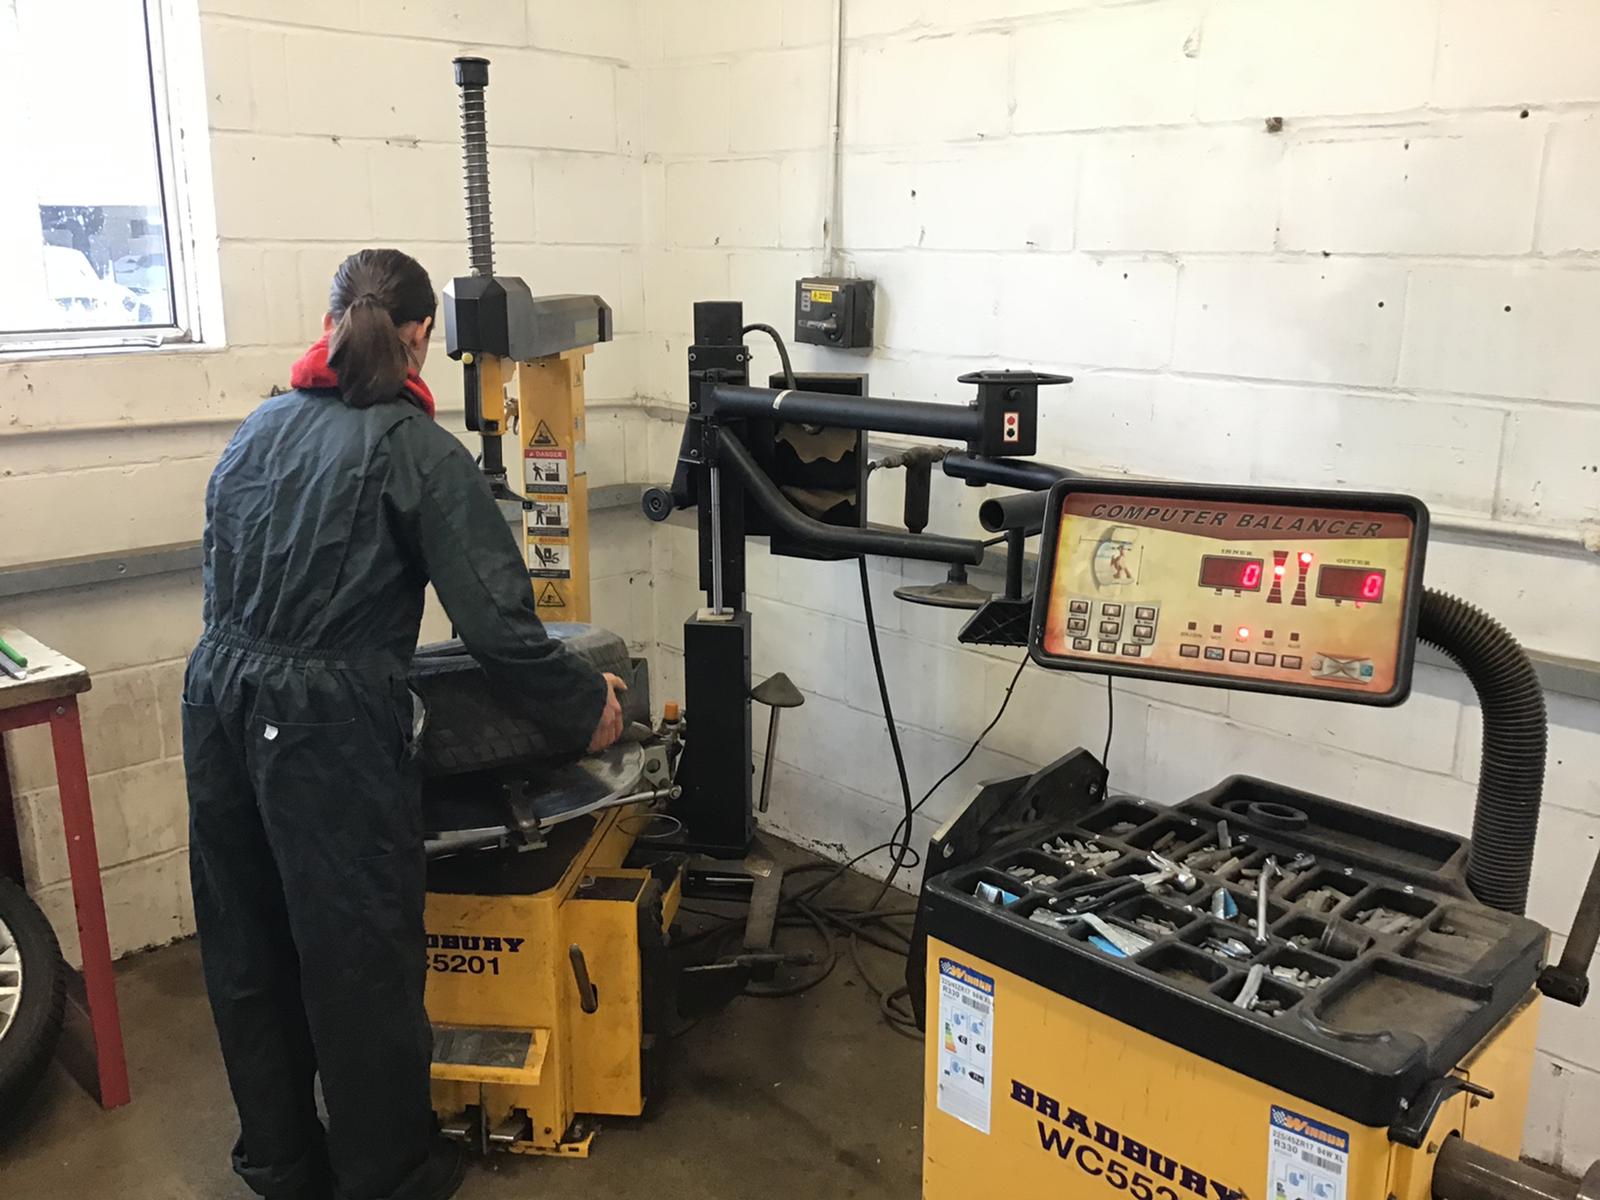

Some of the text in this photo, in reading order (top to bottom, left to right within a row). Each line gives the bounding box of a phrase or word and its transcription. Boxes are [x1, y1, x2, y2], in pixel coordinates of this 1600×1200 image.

[1091, 503, 1382, 538] COMPUTER BALANCER
[1221, 548, 1253, 556] INNER
[1336, 558, 1371, 566] OUTER
[1242, 564, 1260, 586] 0
[1362, 574, 1382, 598] 0
[426, 953, 499, 976] 5201
[1010, 1079, 1246, 1200] BRADBURY
[1273, 1139, 1298, 1154] R330
[1334, 1153, 1345, 1163] XL
